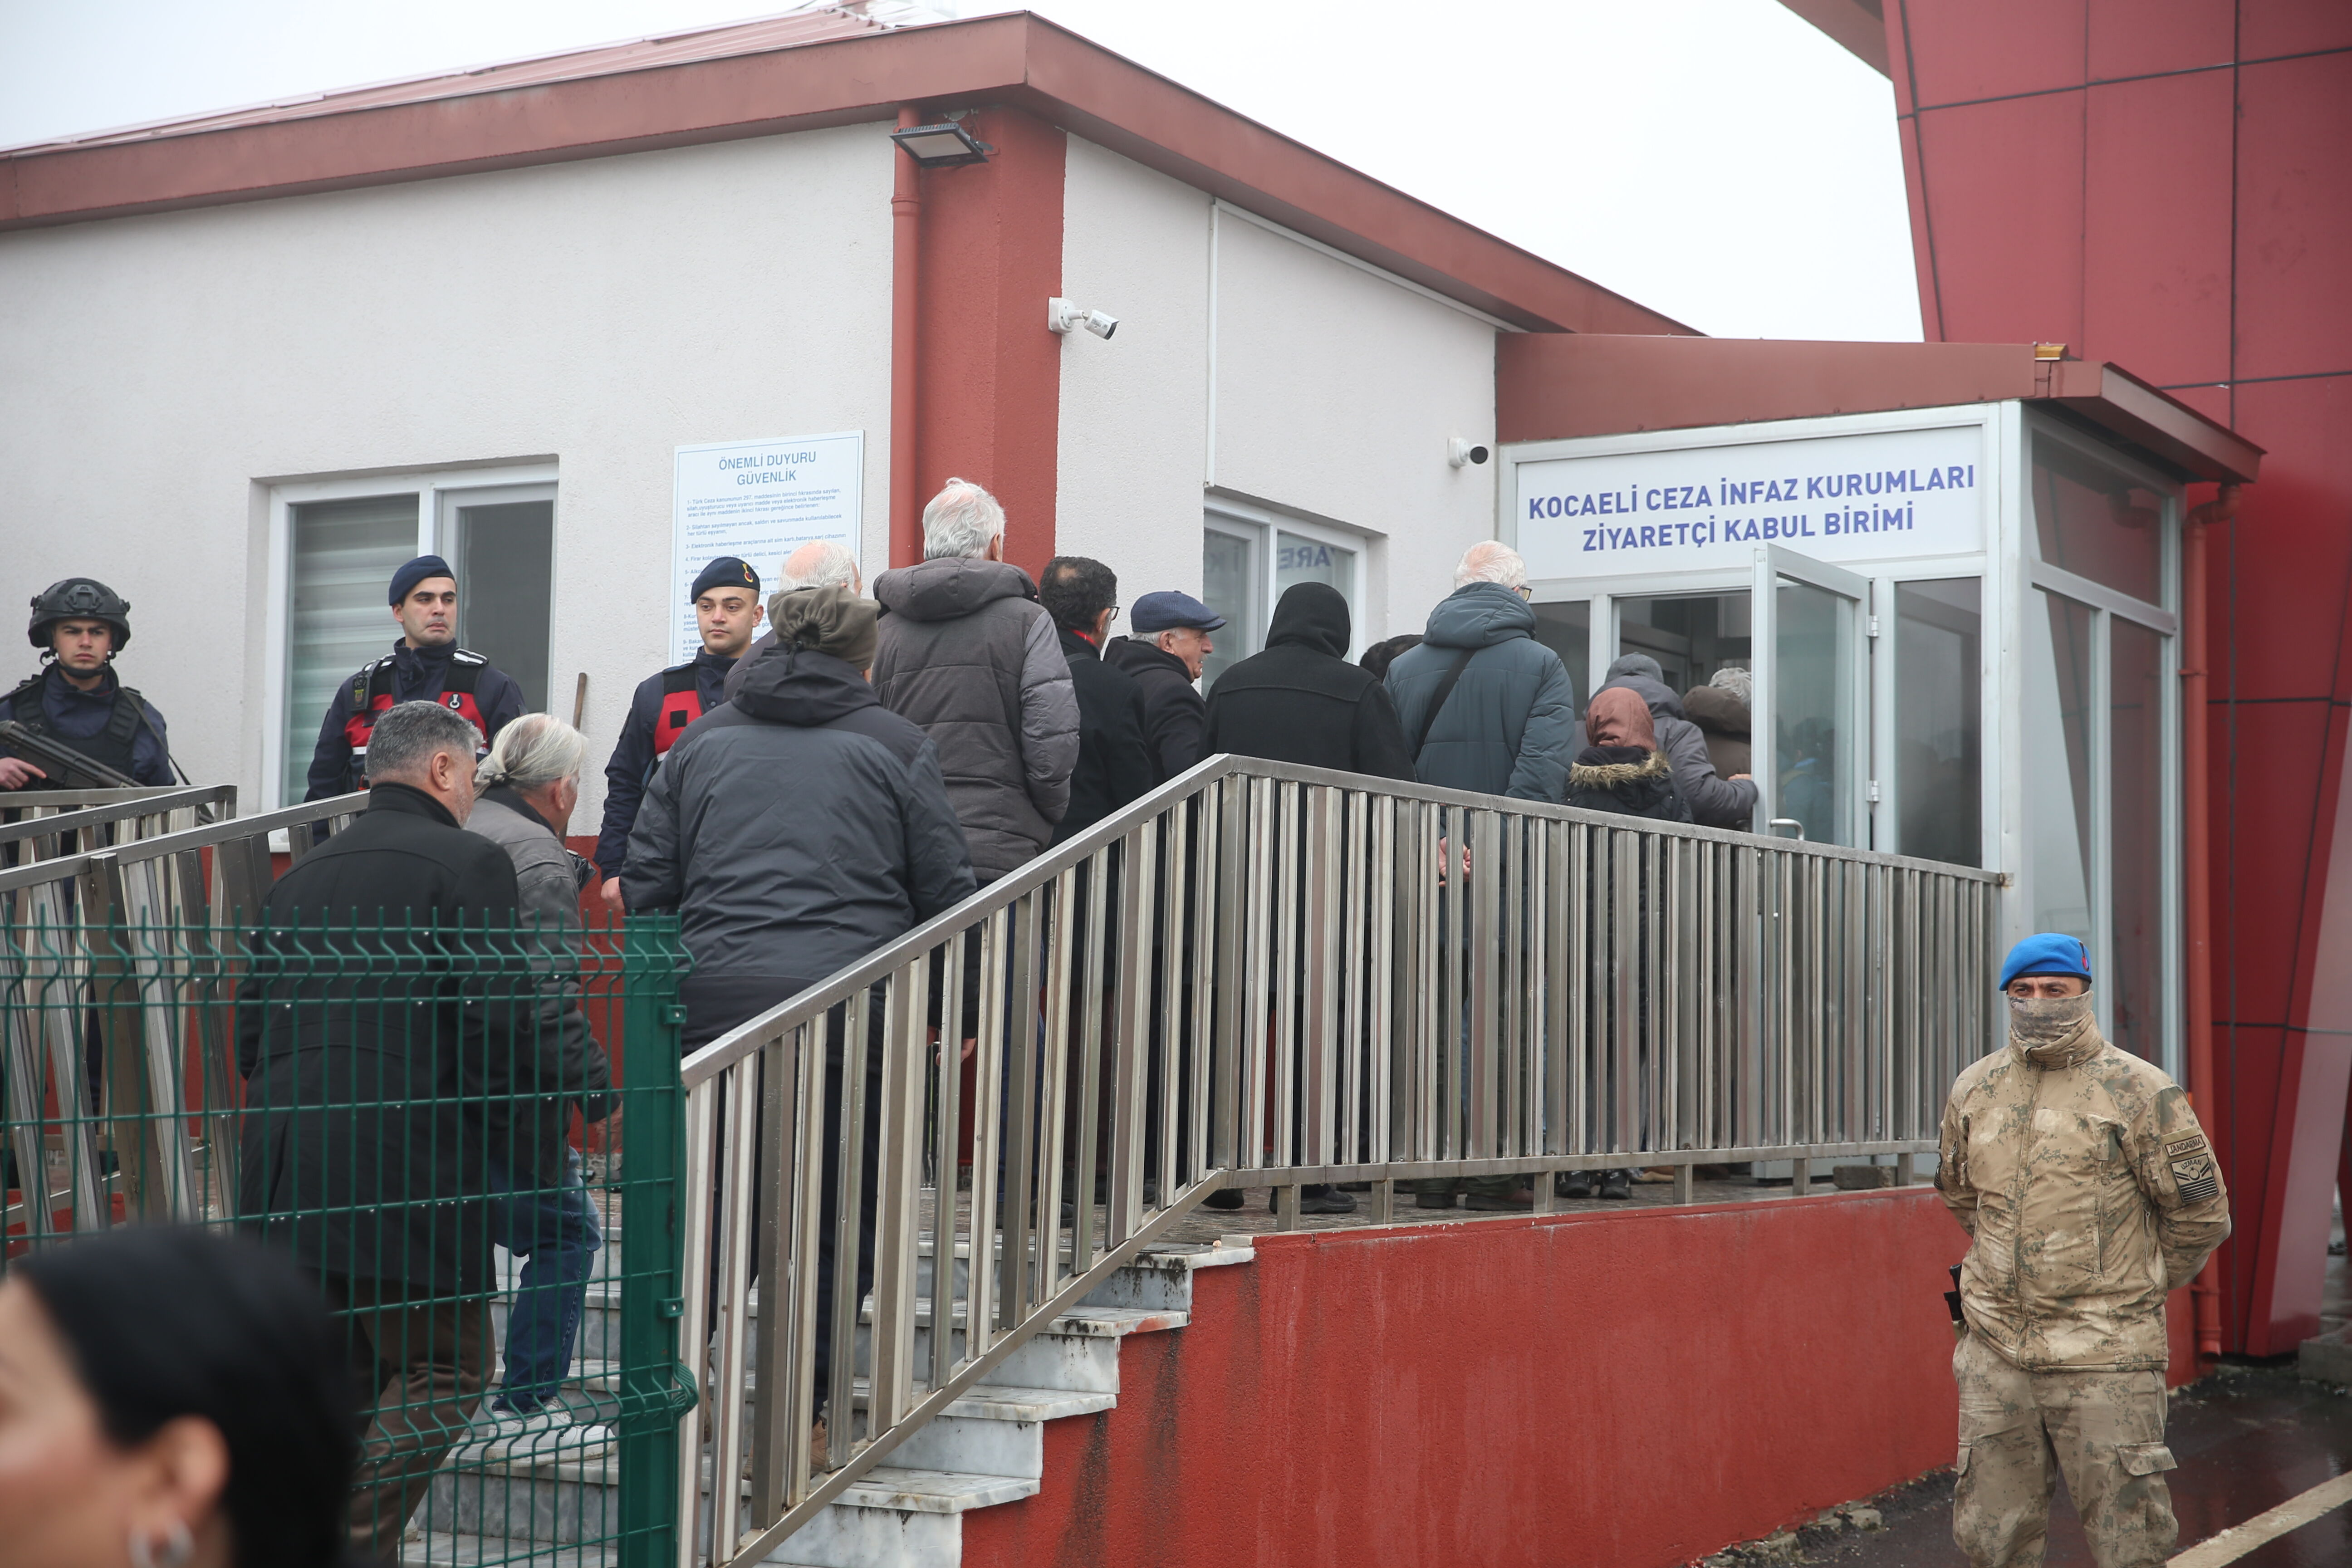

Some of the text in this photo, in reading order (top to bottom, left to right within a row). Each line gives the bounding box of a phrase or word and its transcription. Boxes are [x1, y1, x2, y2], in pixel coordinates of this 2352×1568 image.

[719, 451, 816, 470] ÖNEMLİ DUYURU
[737, 468, 797, 485] GÜVENLİK
[1529, 465, 1974, 519] KOCAELİ CEZA İNFAZ KURUMLARI
[1583, 500, 1913, 551] ZİYARETÇİ KABUL BİRİMİ
[2170, 1137, 2203, 1153] JANDARMA
[2181, 1159, 2202, 1170] UZMAN
